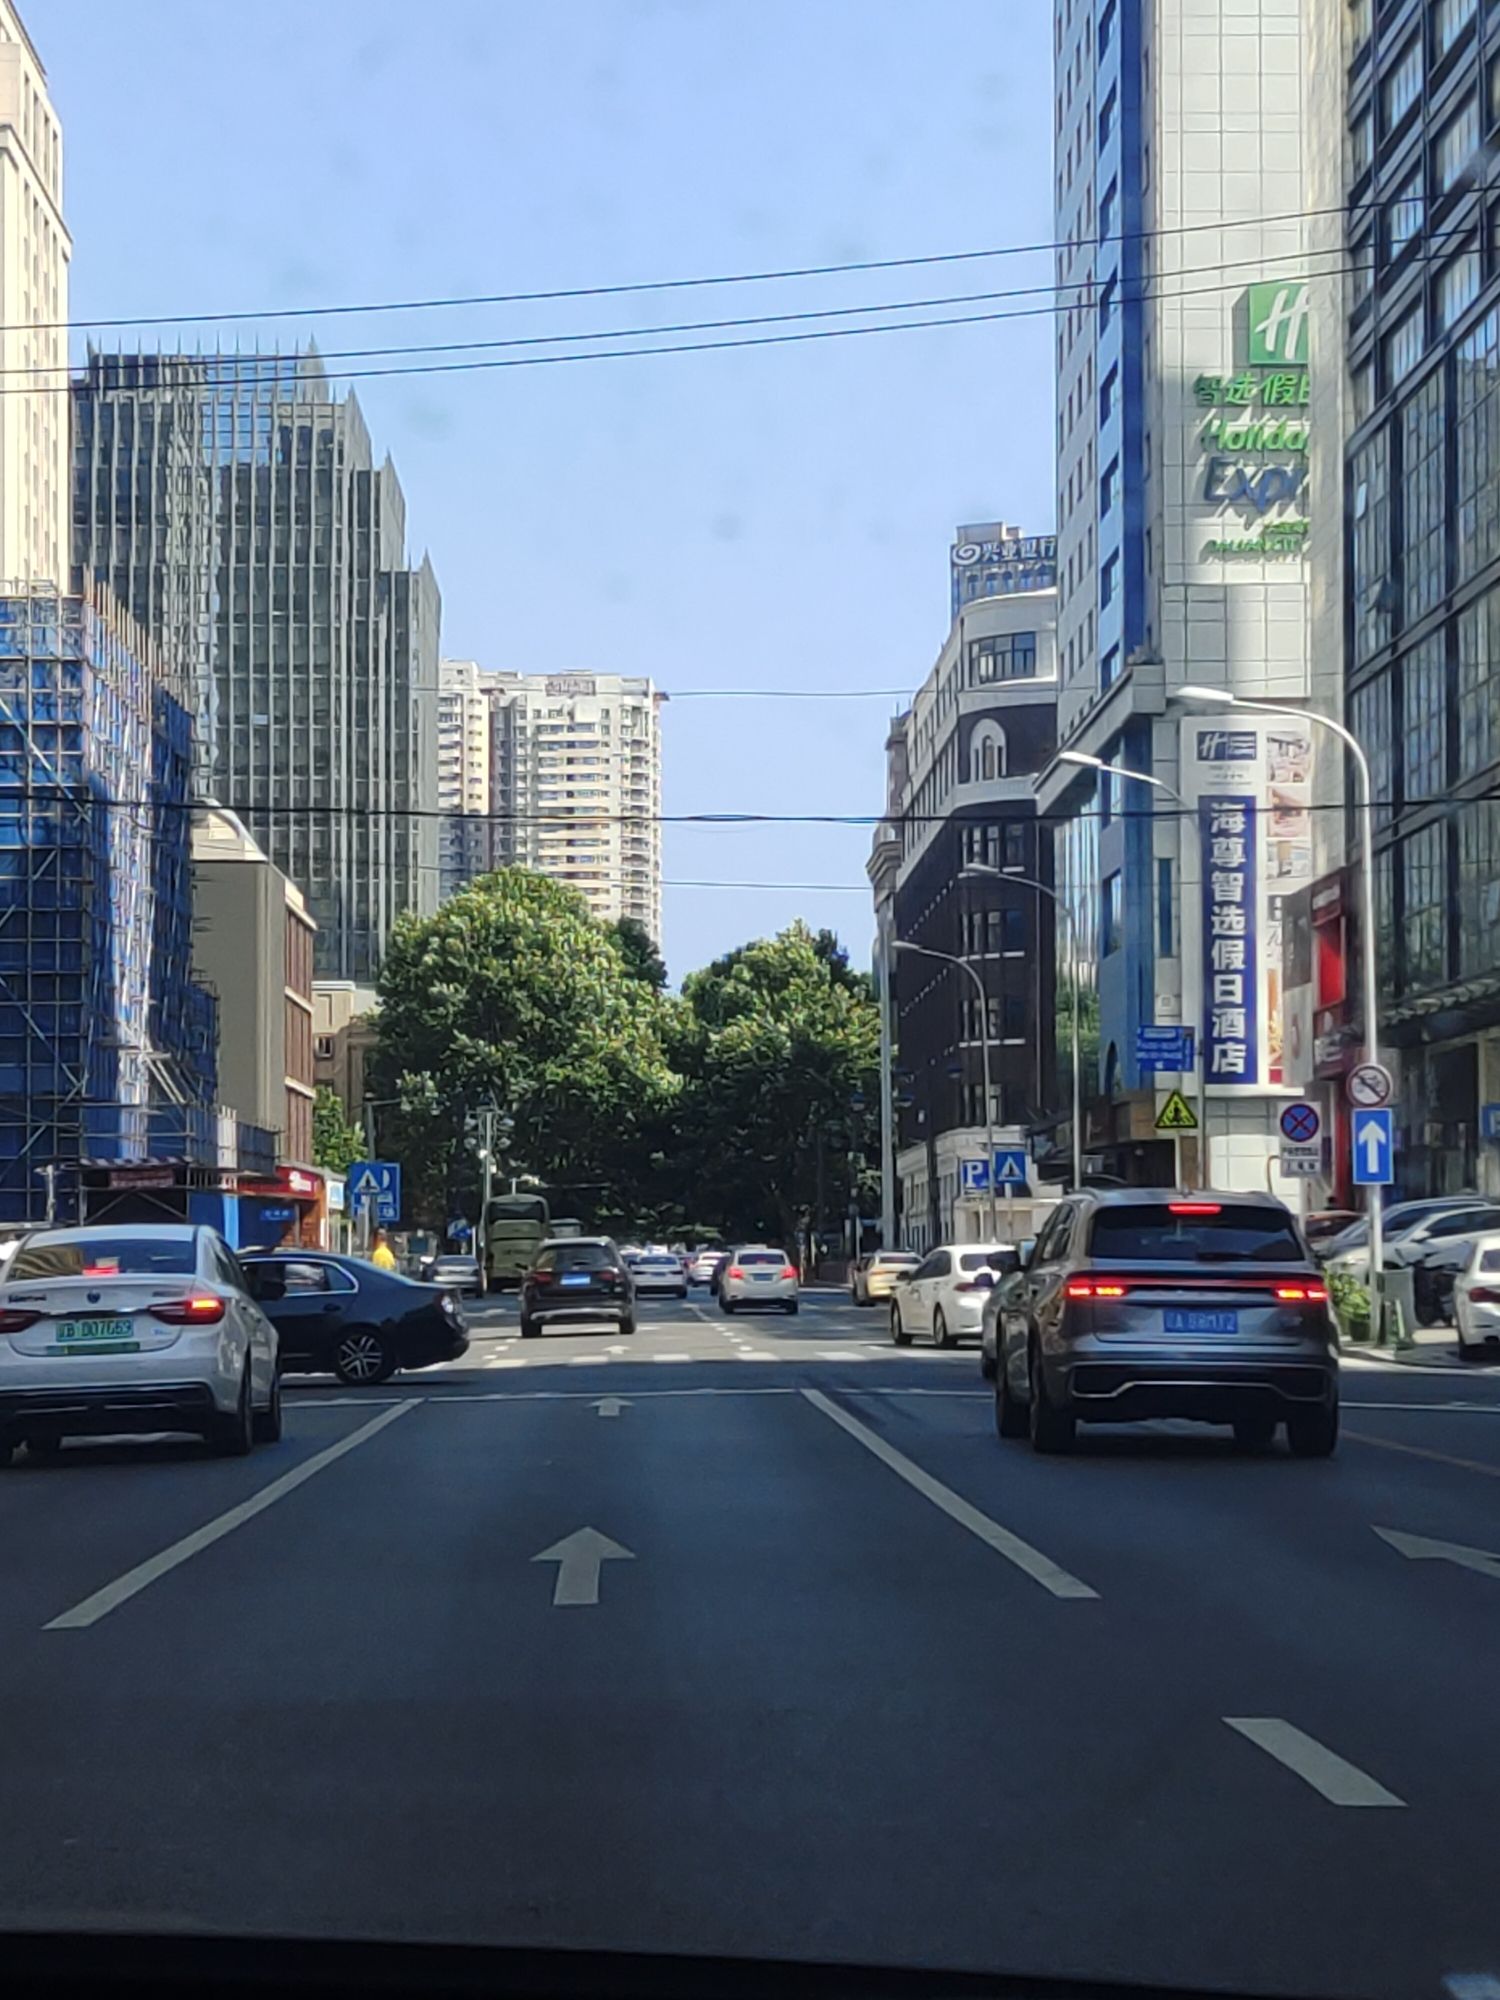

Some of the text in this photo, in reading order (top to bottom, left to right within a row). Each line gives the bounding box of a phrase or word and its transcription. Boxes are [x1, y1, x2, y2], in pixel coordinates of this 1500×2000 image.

[1201, 417, 1308, 452] Holida
[1210, 802, 1247, 1074] 海尊智选假日酒店
[965, 1161, 983, 1188] P
